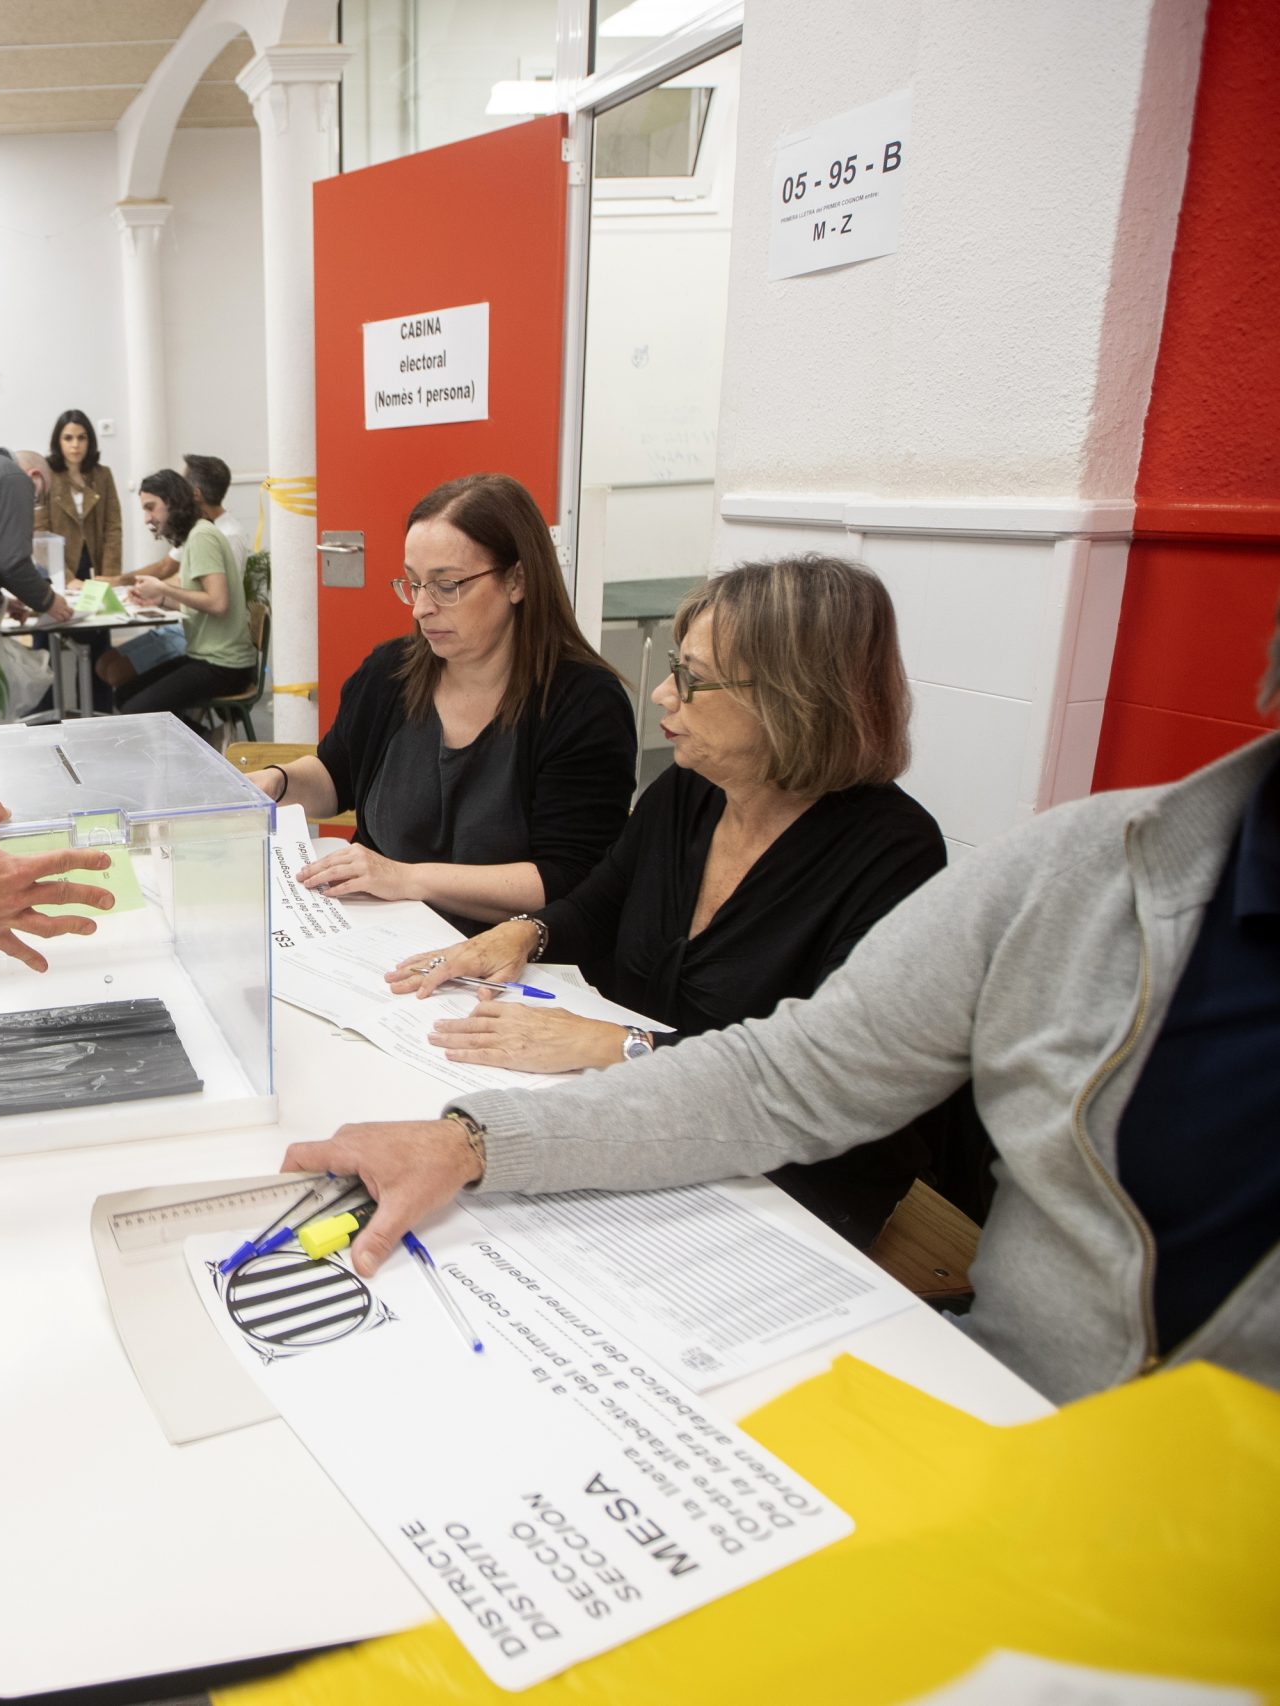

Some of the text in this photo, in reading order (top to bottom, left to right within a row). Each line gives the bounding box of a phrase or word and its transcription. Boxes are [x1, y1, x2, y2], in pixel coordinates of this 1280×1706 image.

[782, 172, 808, 204] 05
[829, 154, 858, 190] 95
[882, 140, 902, 174] B
[813, 220, 827, 242] M
[840, 213, 853, 235] Z
[823, 201, 841, 211] PRIMER
[842, 194, 864, 206] COGNOM
[400, 315, 442, 341] CABINA
[399, 349, 447, 374] electoral
[417, 386, 423, 404] 1
[426, 379, 476, 408] persona)
[272, 845, 292, 879] cognom)
[296, 840, 312, 865] ellido)
[271, 929, 296, 948] ESA
[441, 1262, 512, 1320] cognom)
[472, 1240, 542, 1293] apellido)
[537, 1293, 603, 1337] primer
[508, 1320, 573, 1368] primer
[591, 1339, 630, 1364] del
[563, 1369, 600, 1395] del
[531, 1365, 747, 1557] De la lletra a la
[591, 1361, 796, 1530] De la letra a la
[733, 1447, 824, 1518] (Orden
[584, 1471, 702, 1578] MESA
[690, 1473, 774, 1543] (Ordre
[507, 1520, 613, 1622] SECCIÓ
[520, 1491, 644, 1603] SECCIÓN
[399, 1519, 529, 1661] DISTRICTE
[443, 1521, 563, 1642] DISTRITO
